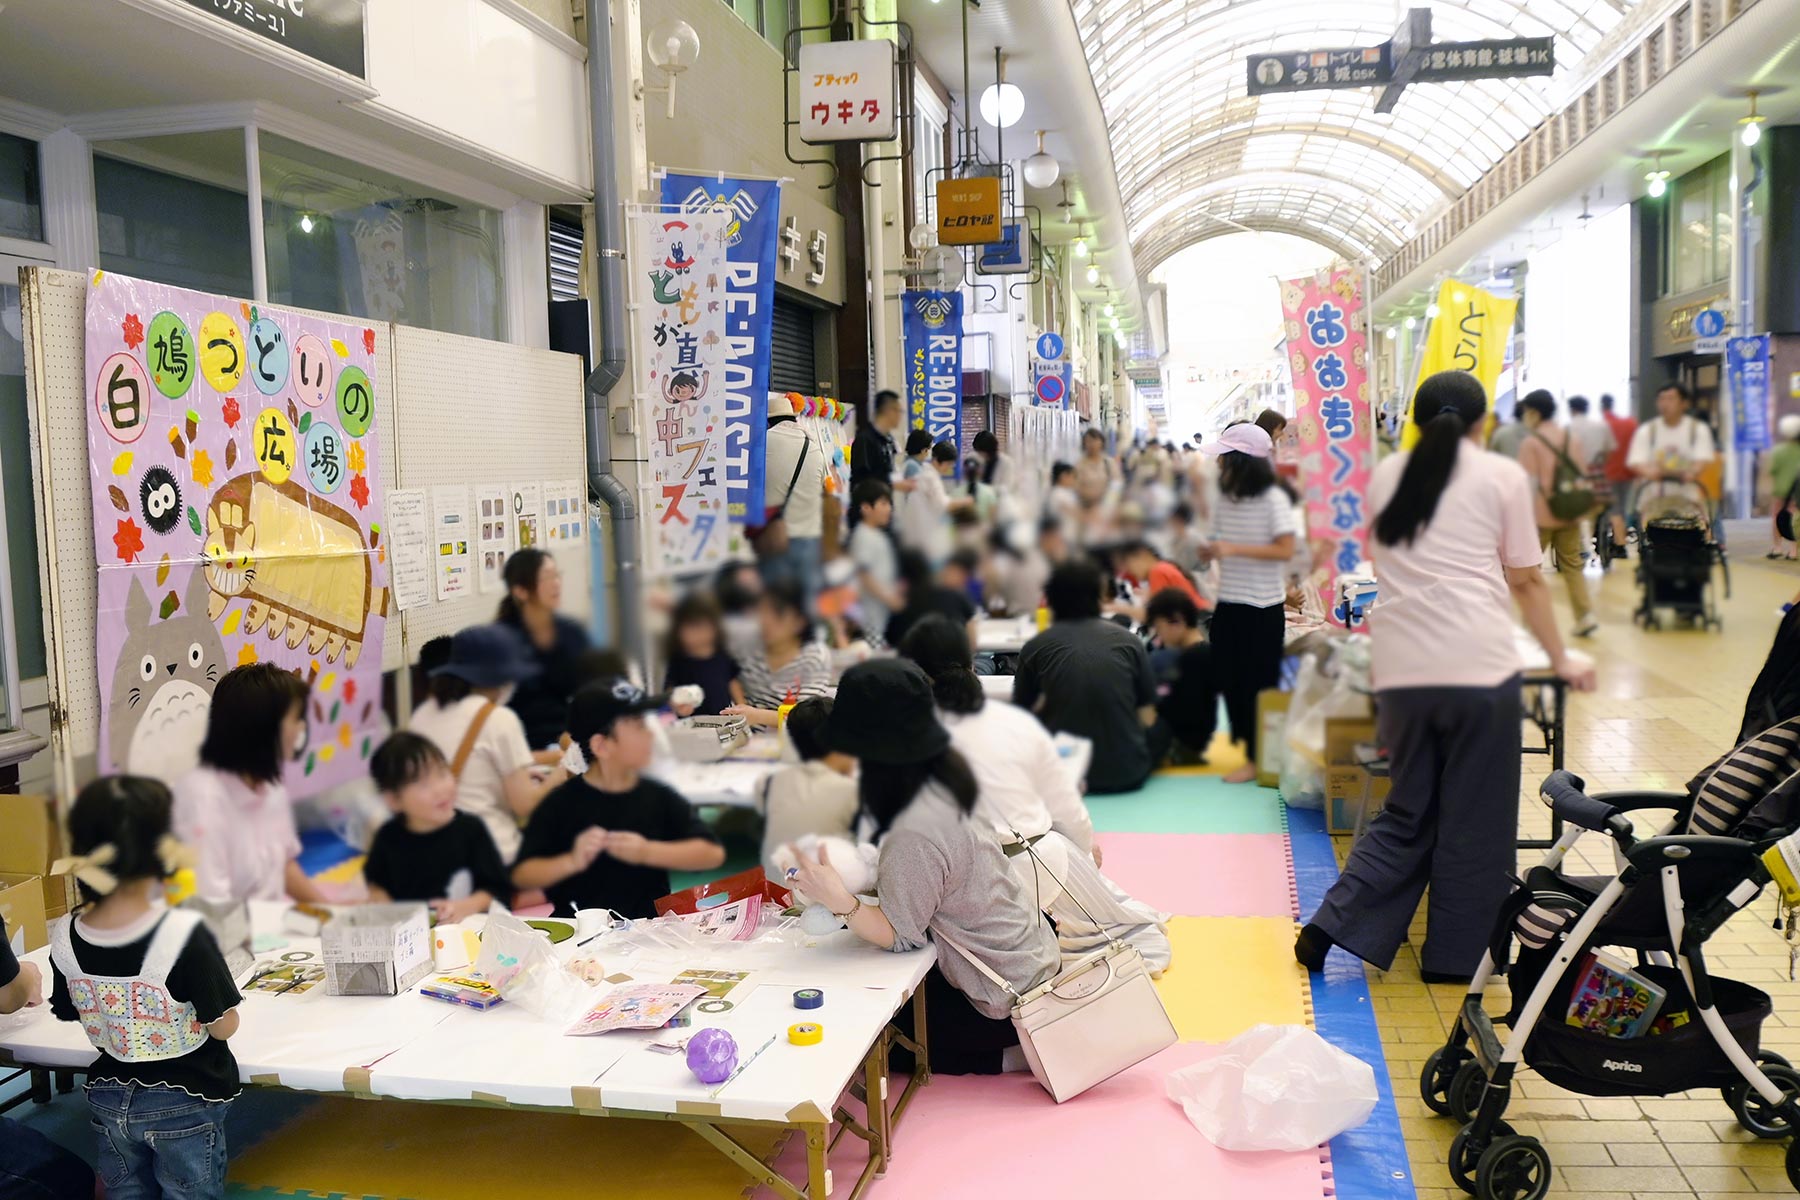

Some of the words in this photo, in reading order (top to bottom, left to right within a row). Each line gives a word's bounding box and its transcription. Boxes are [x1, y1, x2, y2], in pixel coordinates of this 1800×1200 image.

[811, 99, 880, 126] ウキタ
[107, 327, 370, 429] 白鳩つどいの
[929, 335, 957, 447] RE:BOOS
[260, 416, 340, 485] 広場
[1602, 1059, 1643, 1073] Aprica
